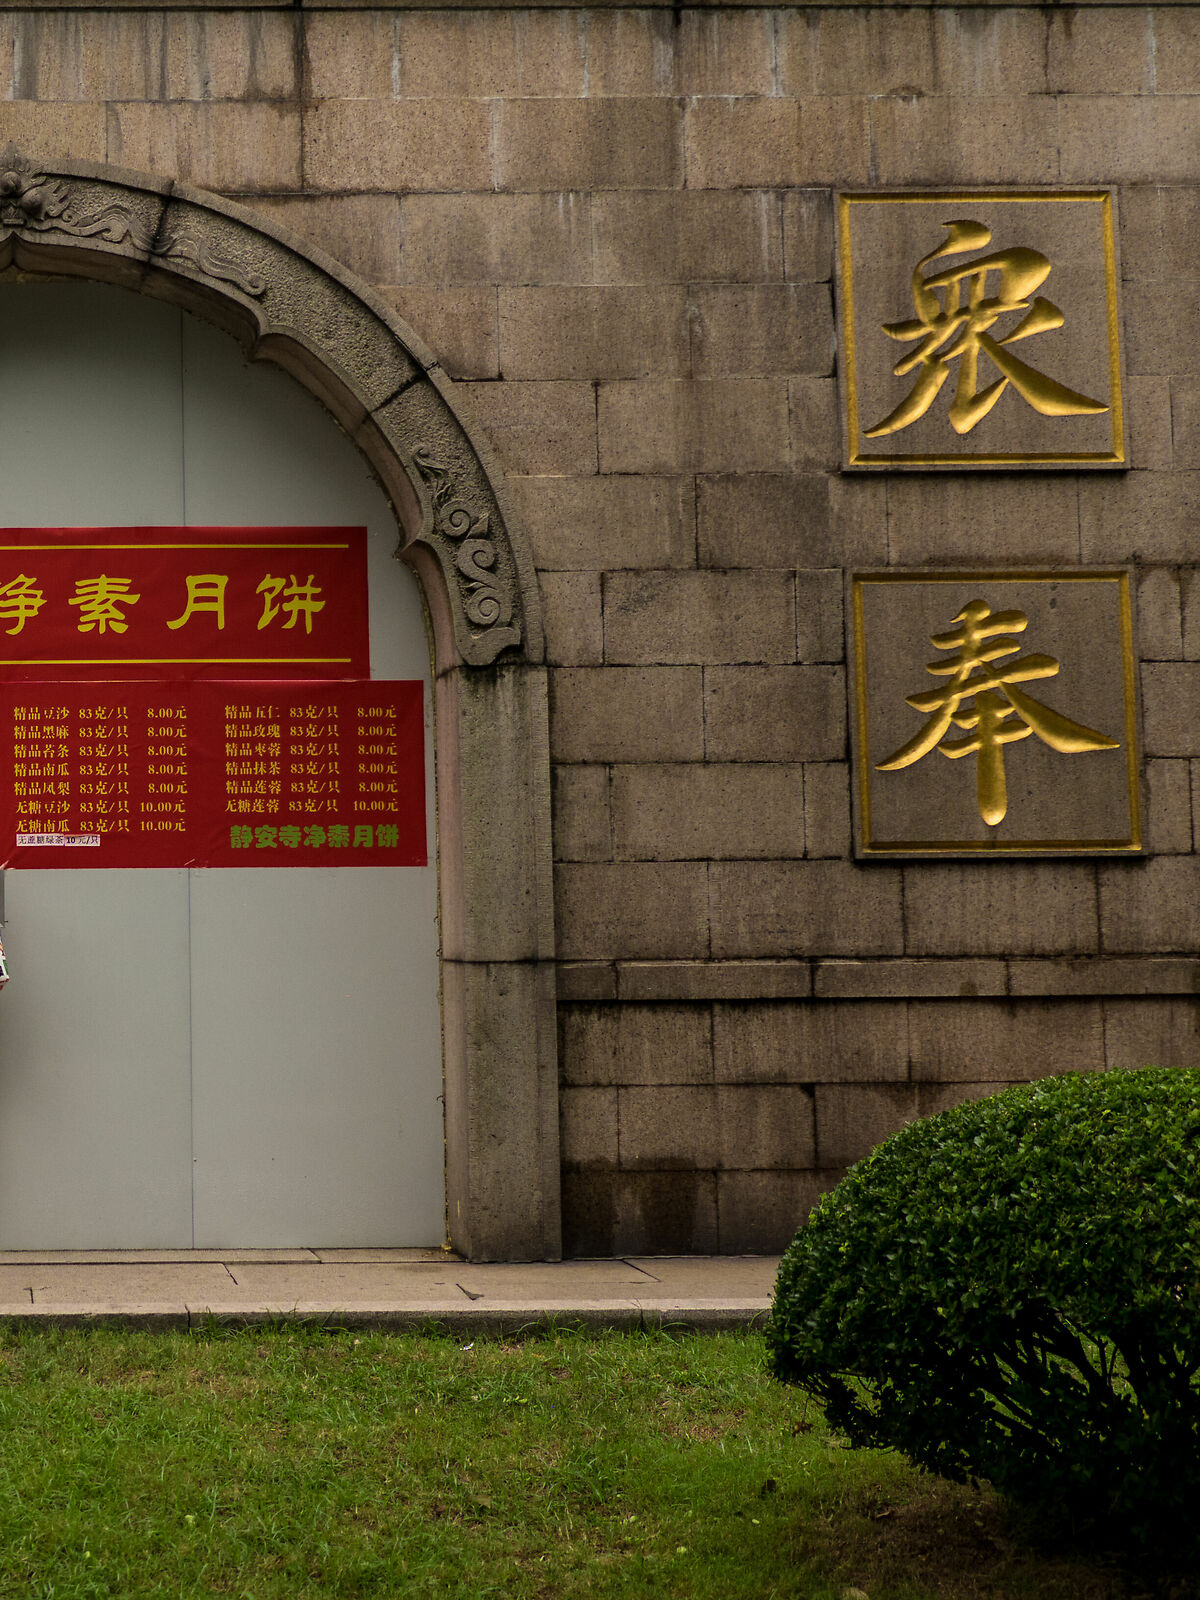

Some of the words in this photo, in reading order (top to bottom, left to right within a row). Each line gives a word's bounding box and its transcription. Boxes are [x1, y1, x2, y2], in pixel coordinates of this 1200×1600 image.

[147, 705, 187, 719] 8.00元
[357, 704, 397, 718] 8.00元
[875, 598, 1120, 827] 奉
[147, 724, 187, 738] 8.00元
[357, 723, 397, 737] 8.00元
[147, 742, 188, 757] 8.00元
[358, 742, 398, 756] 8.00元
[147, 761, 188, 776] 8.00元
[358, 761, 398, 775] 8.00元
[148, 780, 188, 794] 8.00元
[358, 779, 398, 793] 8.00元
[140, 799, 186, 814] 10.00元
[354, 798, 399, 812] 10.00元
[141, 818, 186, 832] 10.00元
